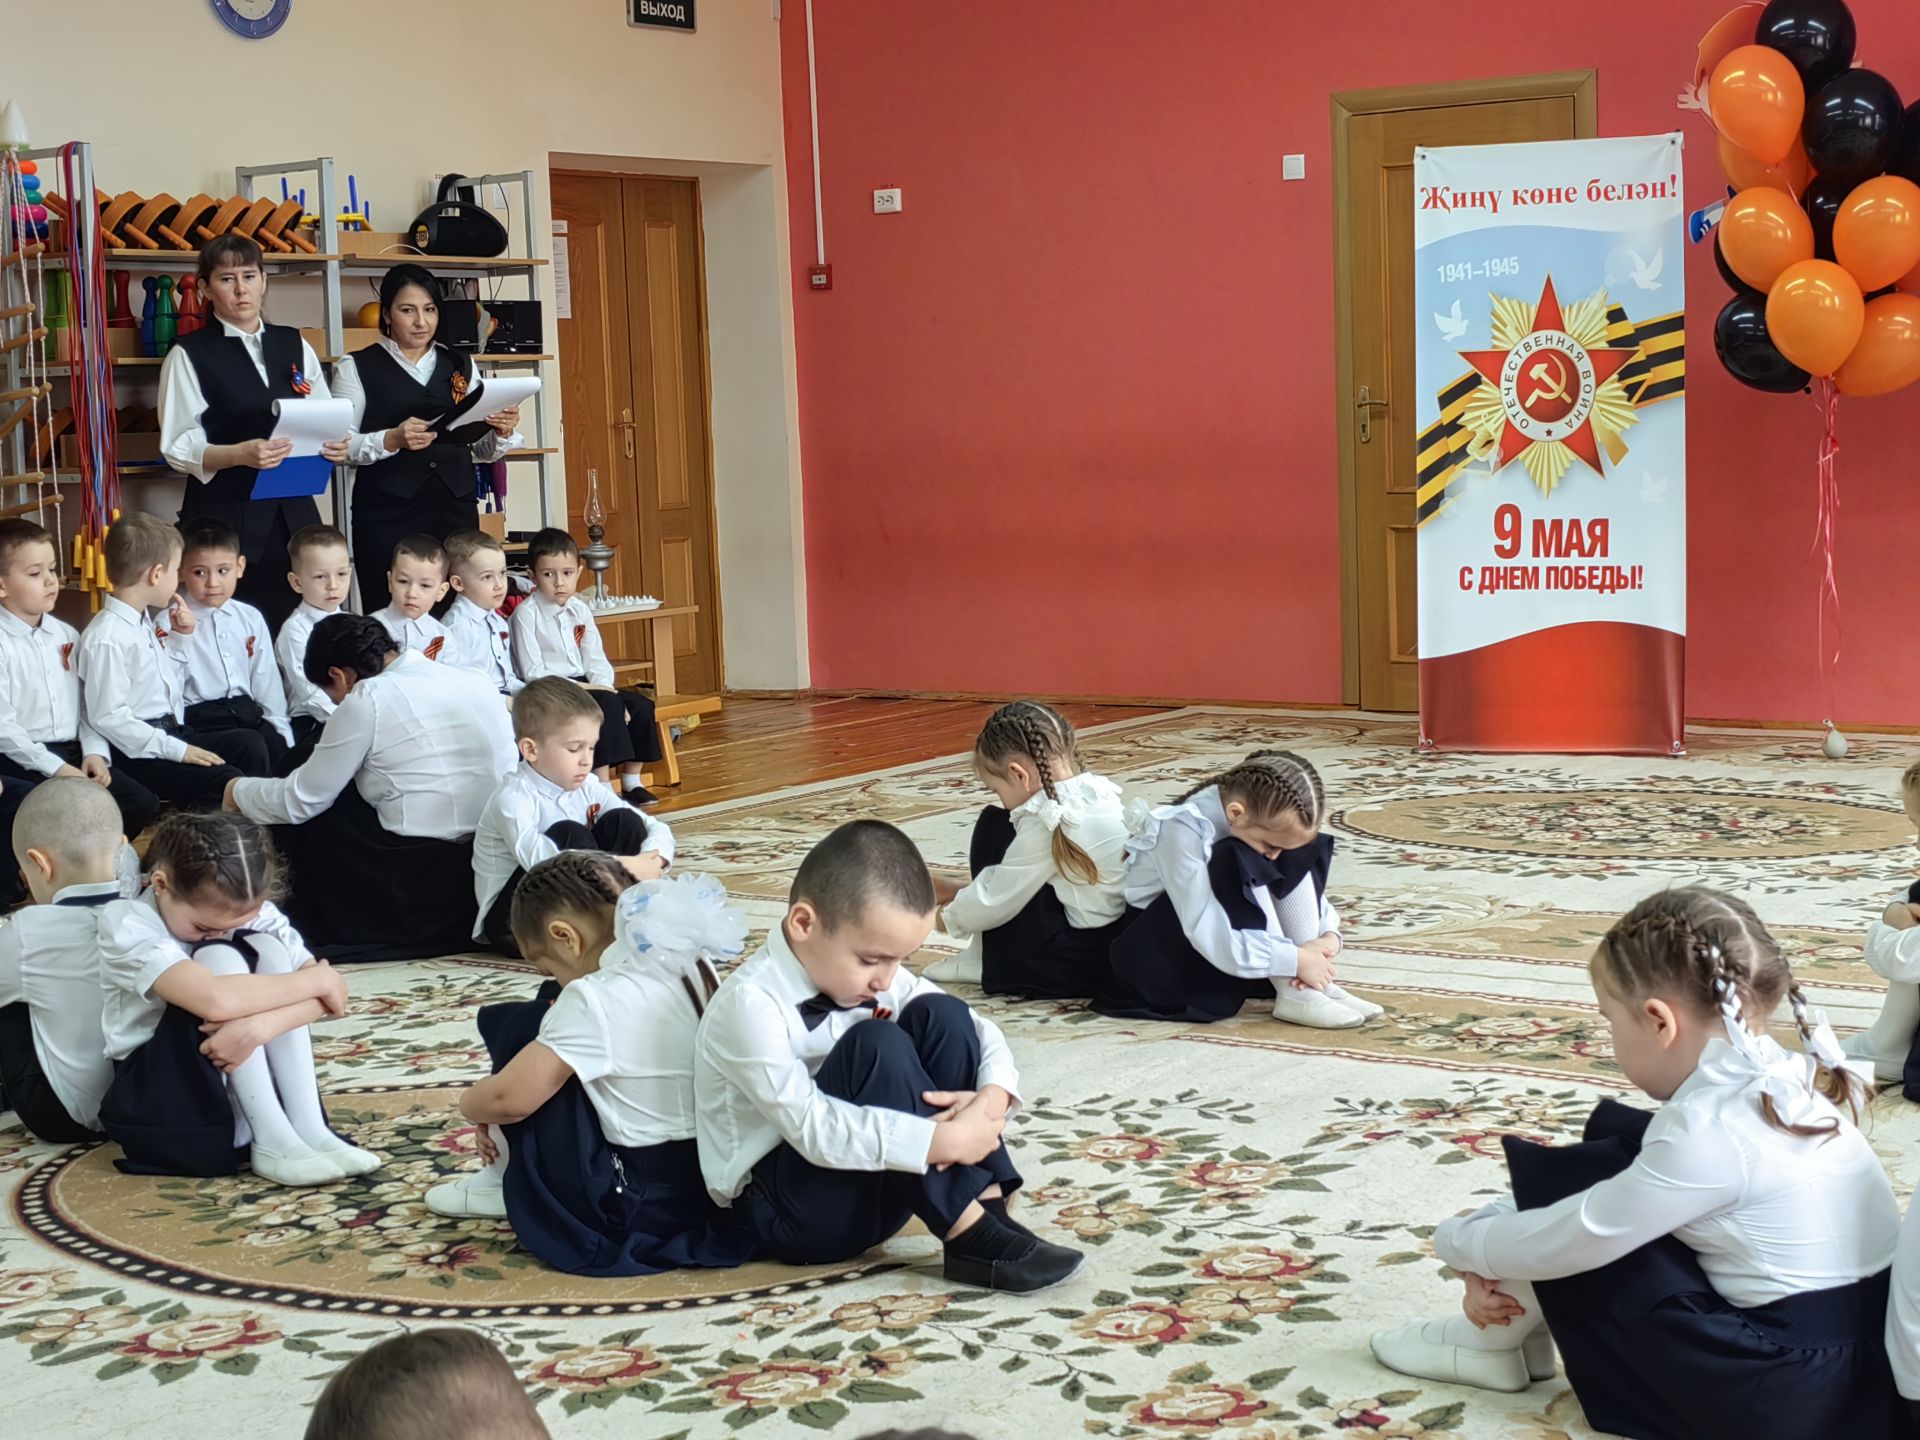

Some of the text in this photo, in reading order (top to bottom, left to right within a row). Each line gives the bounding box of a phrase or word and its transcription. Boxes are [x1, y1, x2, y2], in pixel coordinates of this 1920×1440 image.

[640, 1, 685, 22] ВЫХОД
[1420, 174, 1677, 214] Җиңү көне белән!
[1504, 334, 1585, 429] ОТЕЧЕСТВЕННАЯ
[1493, 503, 1609, 559] 9 МАЯ
[1459, 565, 1643, 595] С ДНЕМ ПОБЕДЫ!
